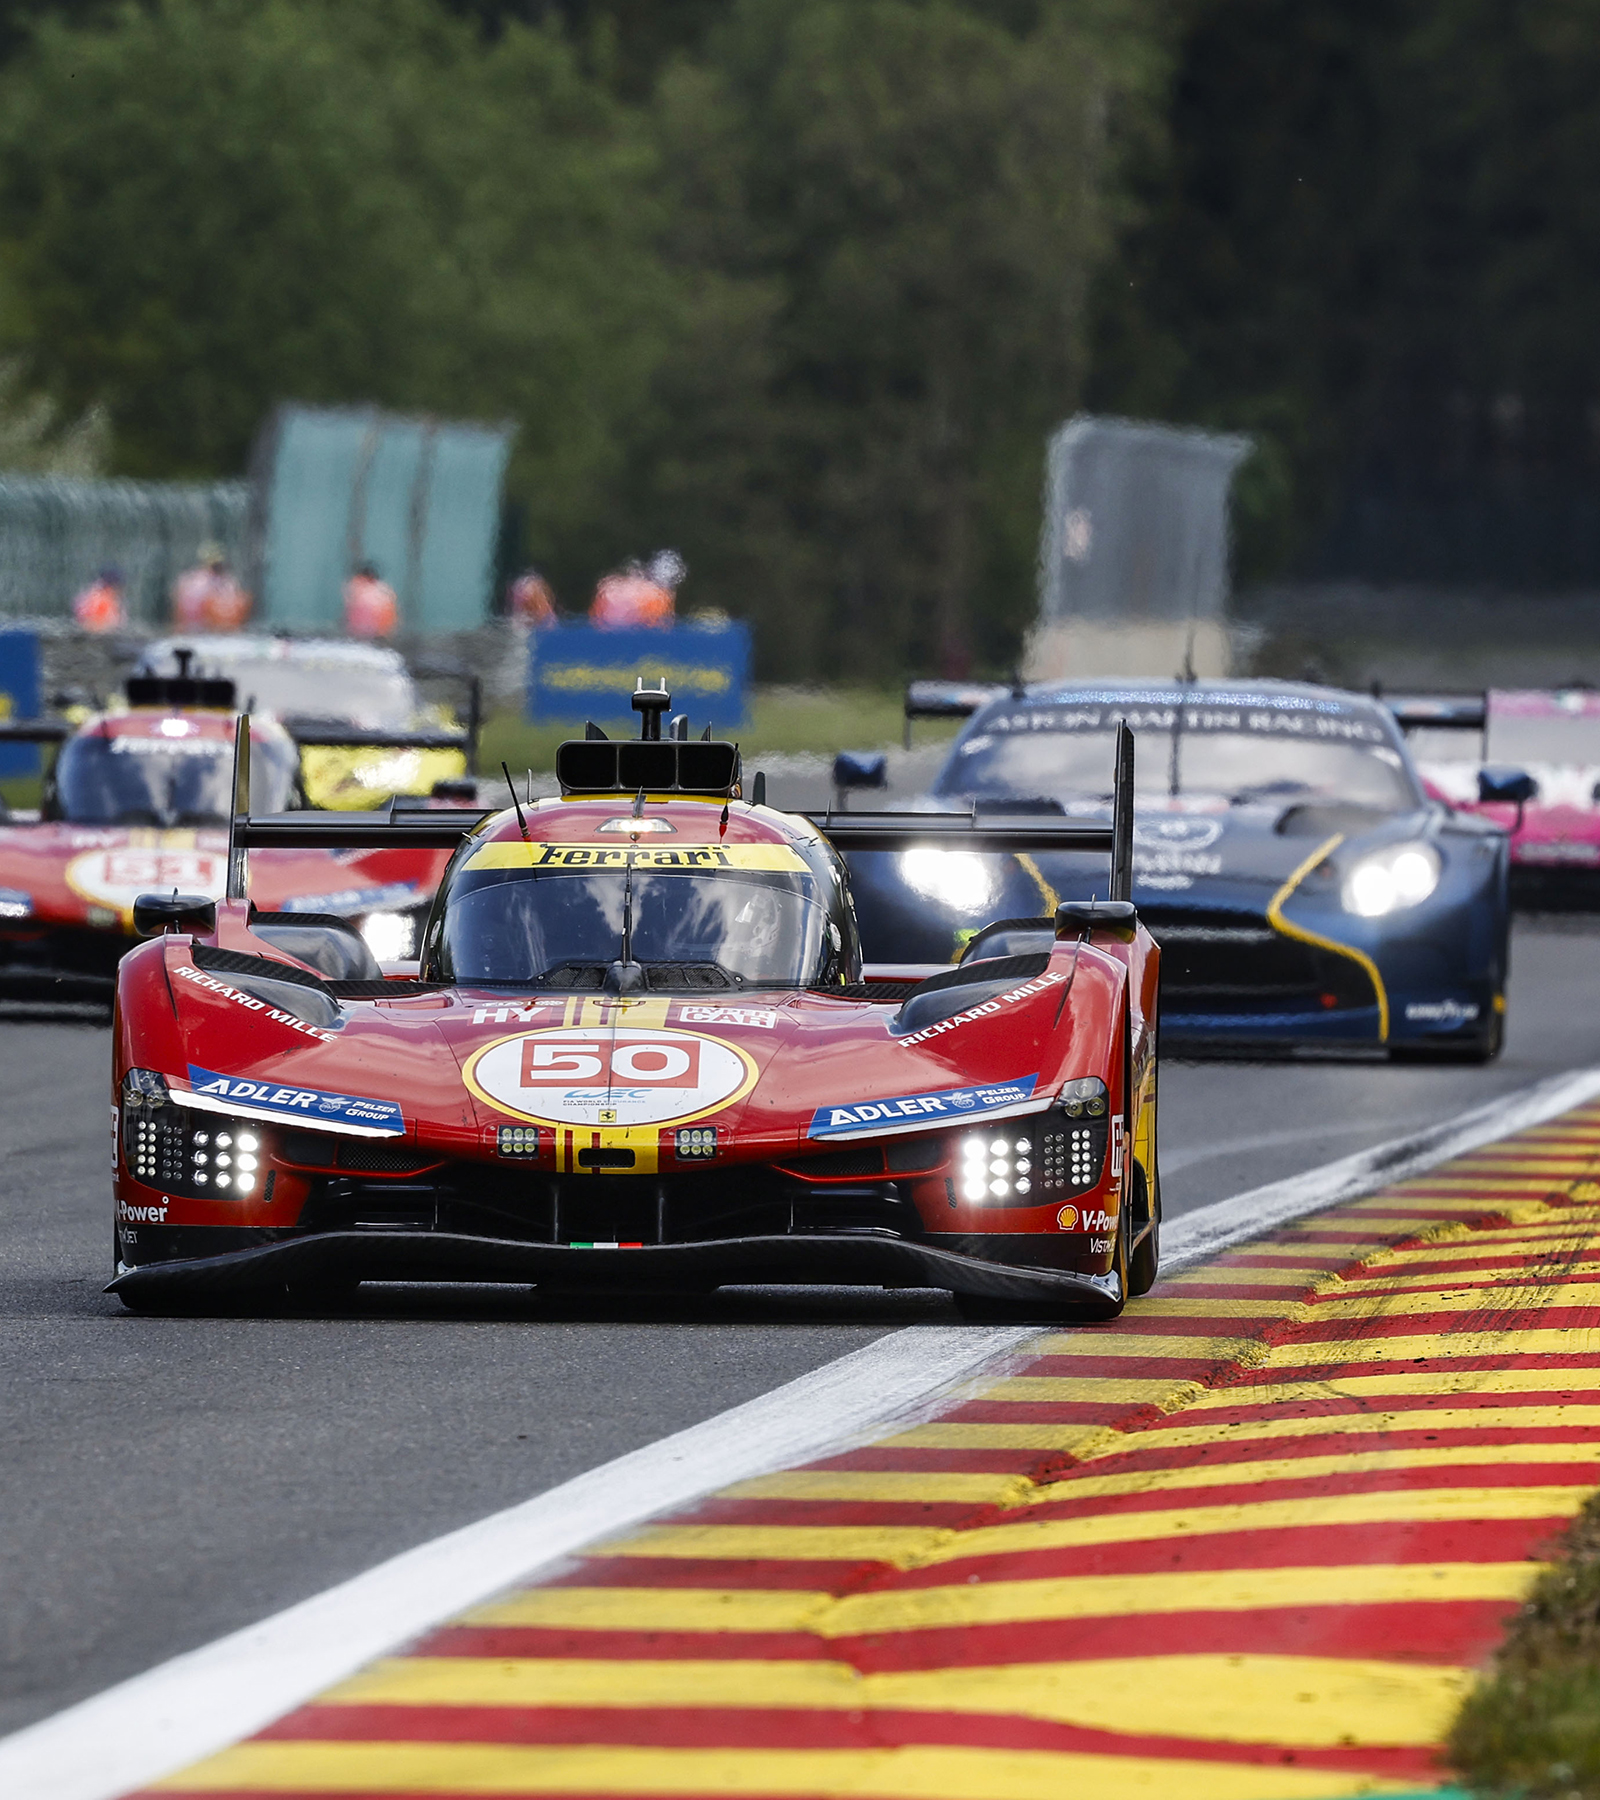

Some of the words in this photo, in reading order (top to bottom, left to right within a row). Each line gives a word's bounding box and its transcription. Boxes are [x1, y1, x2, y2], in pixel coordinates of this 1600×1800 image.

[531, 844, 734, 867] Ferrari
[173, 966, 266, 1012] RICHARD
[265, 1009, 339, 1043] MILLE
[897, 1001, 1002, 1048] RICHARD
[1002, 971, 1068, 1004] MILLE
[472, 1007, 547, 1024] HY
[686, 1012, 768, 1026] CAR
[530, 1044, 690, 1081] 50
[198, 1078, 318, 1109] ADLER
[563, 1089, 653, 1099] WEC
[975, 1086, 1021, 1098] PELZER
[982, 1093, 1027, 1105] GROUP
[345, 1108, 390, 1121] GROUP
[352, 1100, 398, 1114] PELZER
[829, 1096, 948, 1126] ADLER
